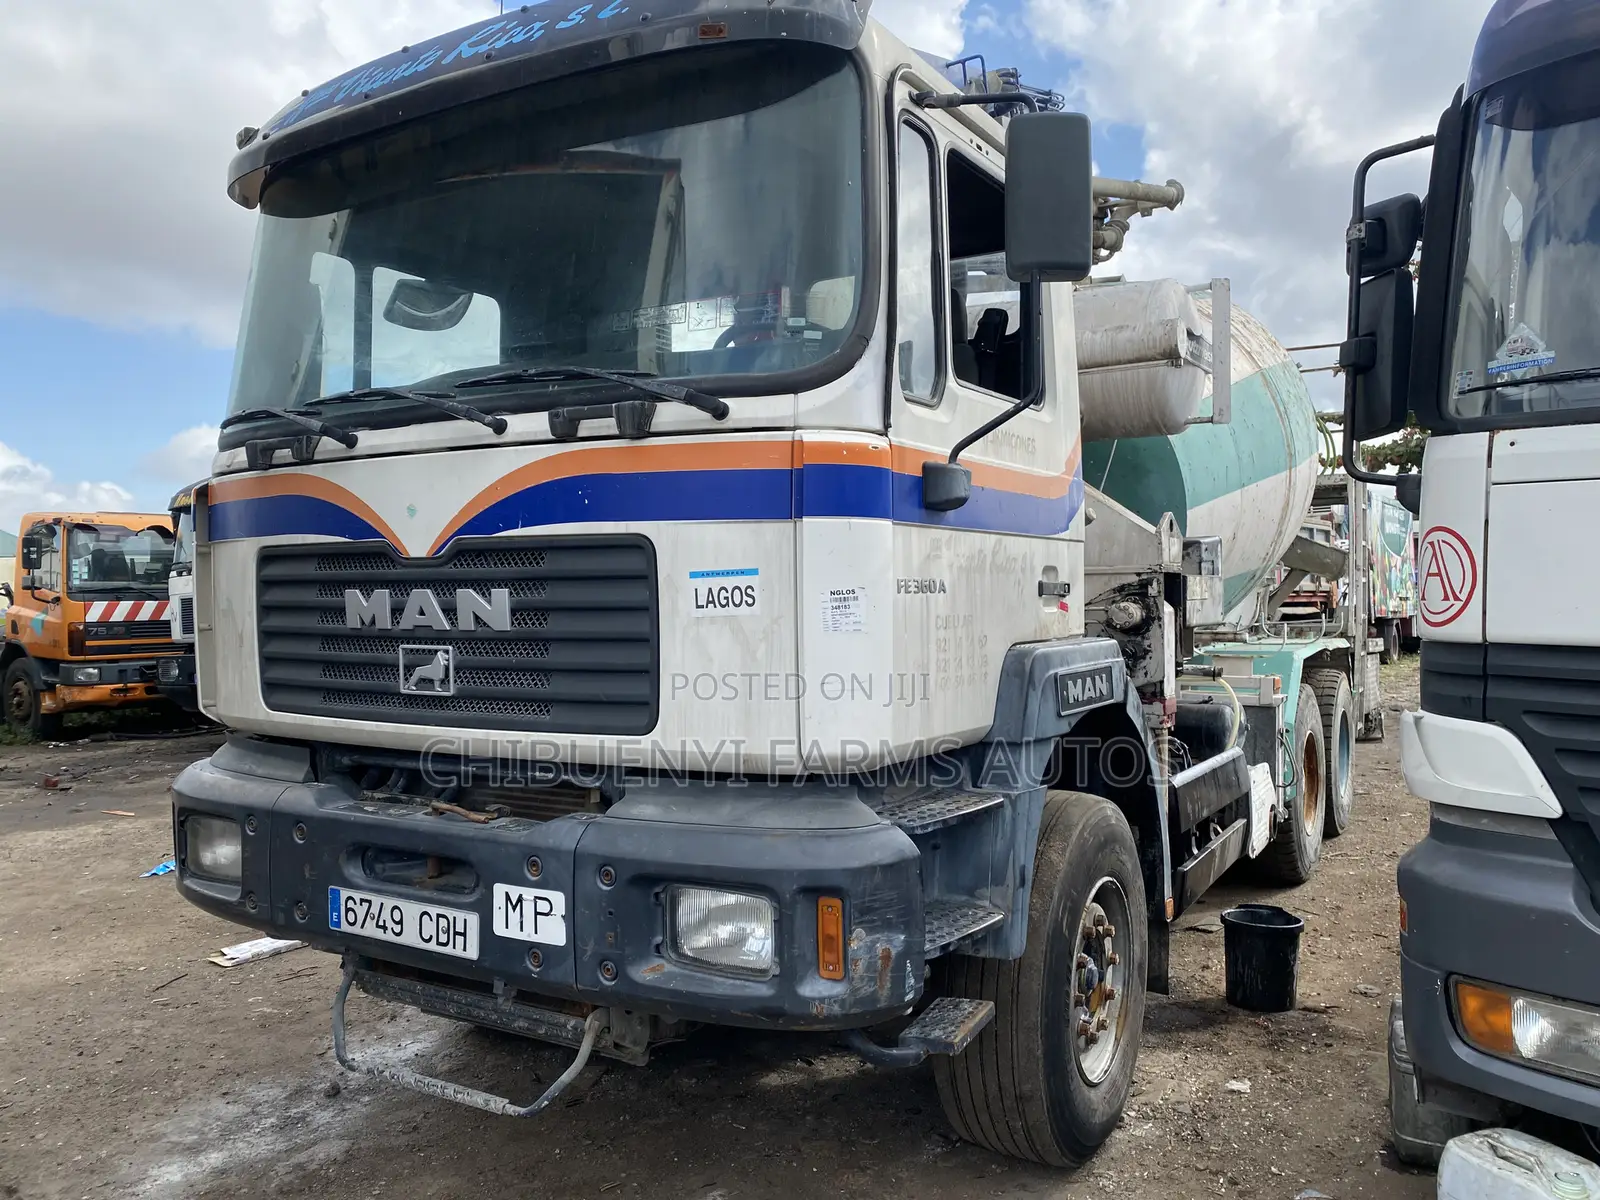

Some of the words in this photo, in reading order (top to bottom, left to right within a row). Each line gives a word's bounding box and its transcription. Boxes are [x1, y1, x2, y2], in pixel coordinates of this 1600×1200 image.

[694, 584, 756, 609] LAGOS
[829, 588, 856, 597] NGLOS
[344, 587, 513, 633] MAN
[88, 627, 107, 636] 75
[1067, 673, 1108, 704] MAN
[332, 912, 339, 922] E
[344, 895, 404, 937] 6749
[418, 910, 467, 952] CDH
[504, 890, 554, 935] MP
